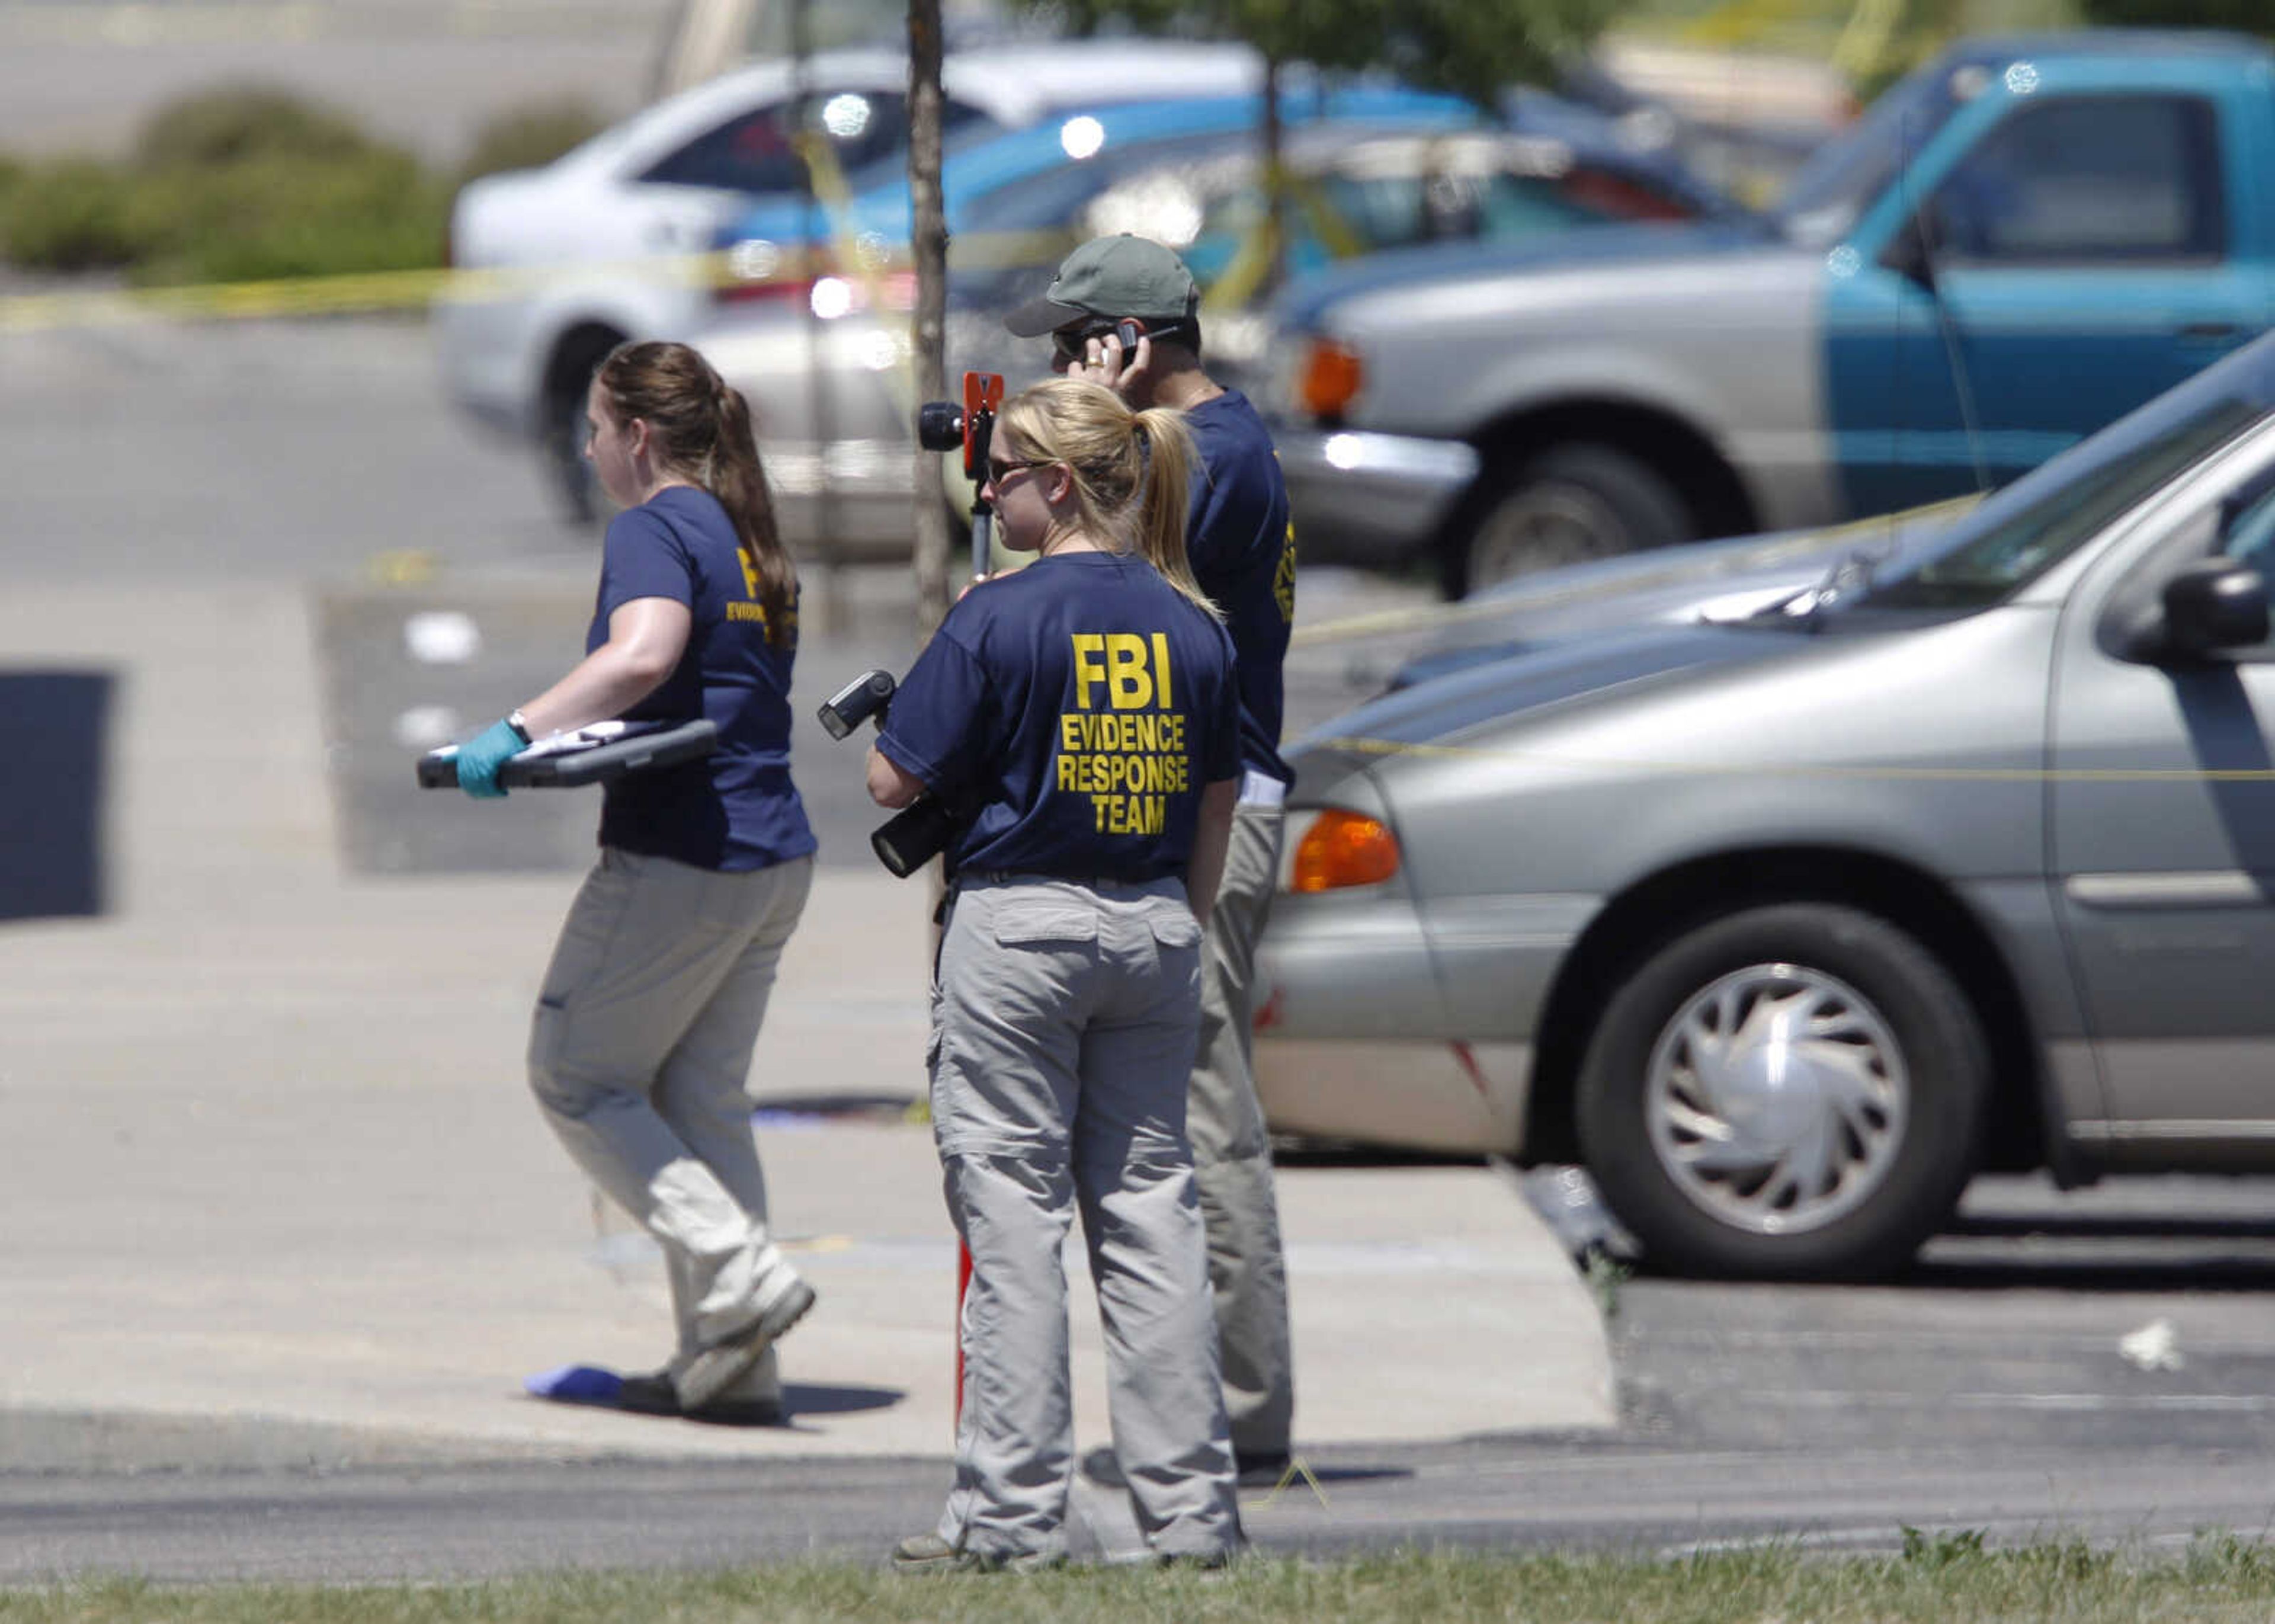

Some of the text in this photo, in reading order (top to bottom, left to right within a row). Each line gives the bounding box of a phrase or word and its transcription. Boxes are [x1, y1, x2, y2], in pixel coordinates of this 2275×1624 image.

[1071, 632, 1172, 709] FBI
[1060, 714, 1184, 751] EVIDENCE
[1058, 755, 1188, 792] RESPONSE
[1091, 795, 1165, 834] TEAM
